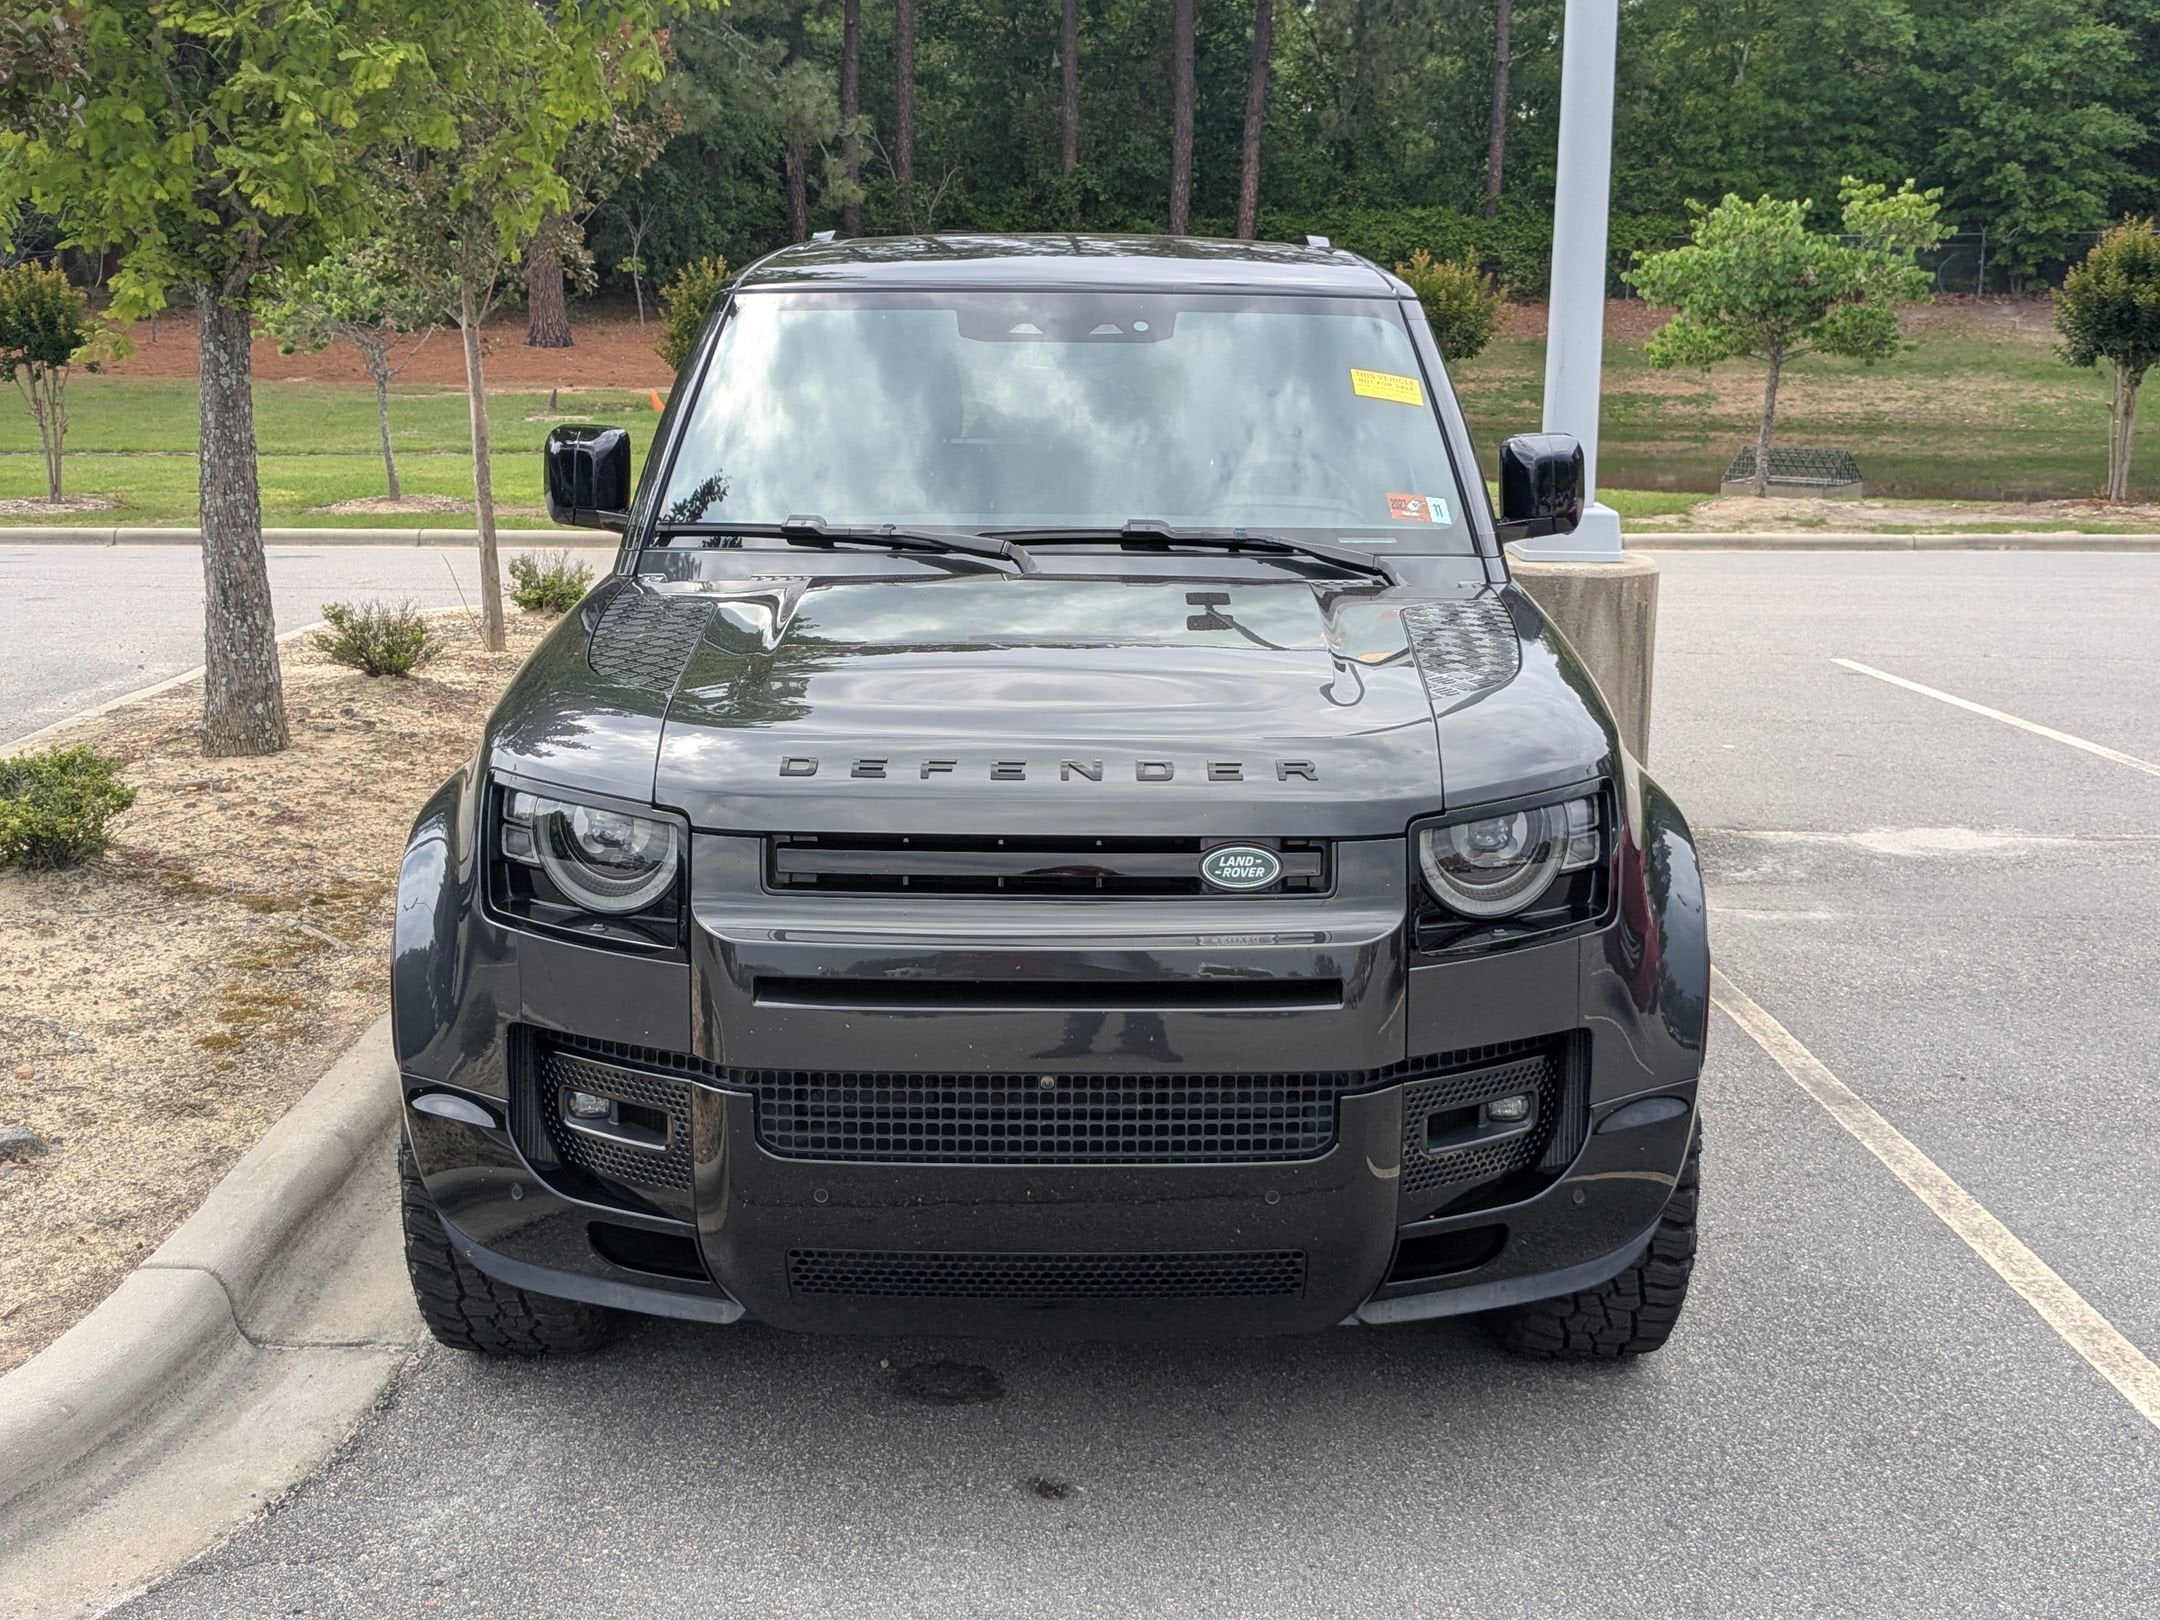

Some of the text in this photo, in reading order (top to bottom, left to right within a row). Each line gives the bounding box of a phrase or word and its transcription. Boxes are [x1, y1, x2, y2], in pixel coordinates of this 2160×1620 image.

[1355, 371, 1415, 385] THIS VEHICLE
[1395, 383, 1414, 391] SALE
[779, 756, 1319, 781] DEFENDER
